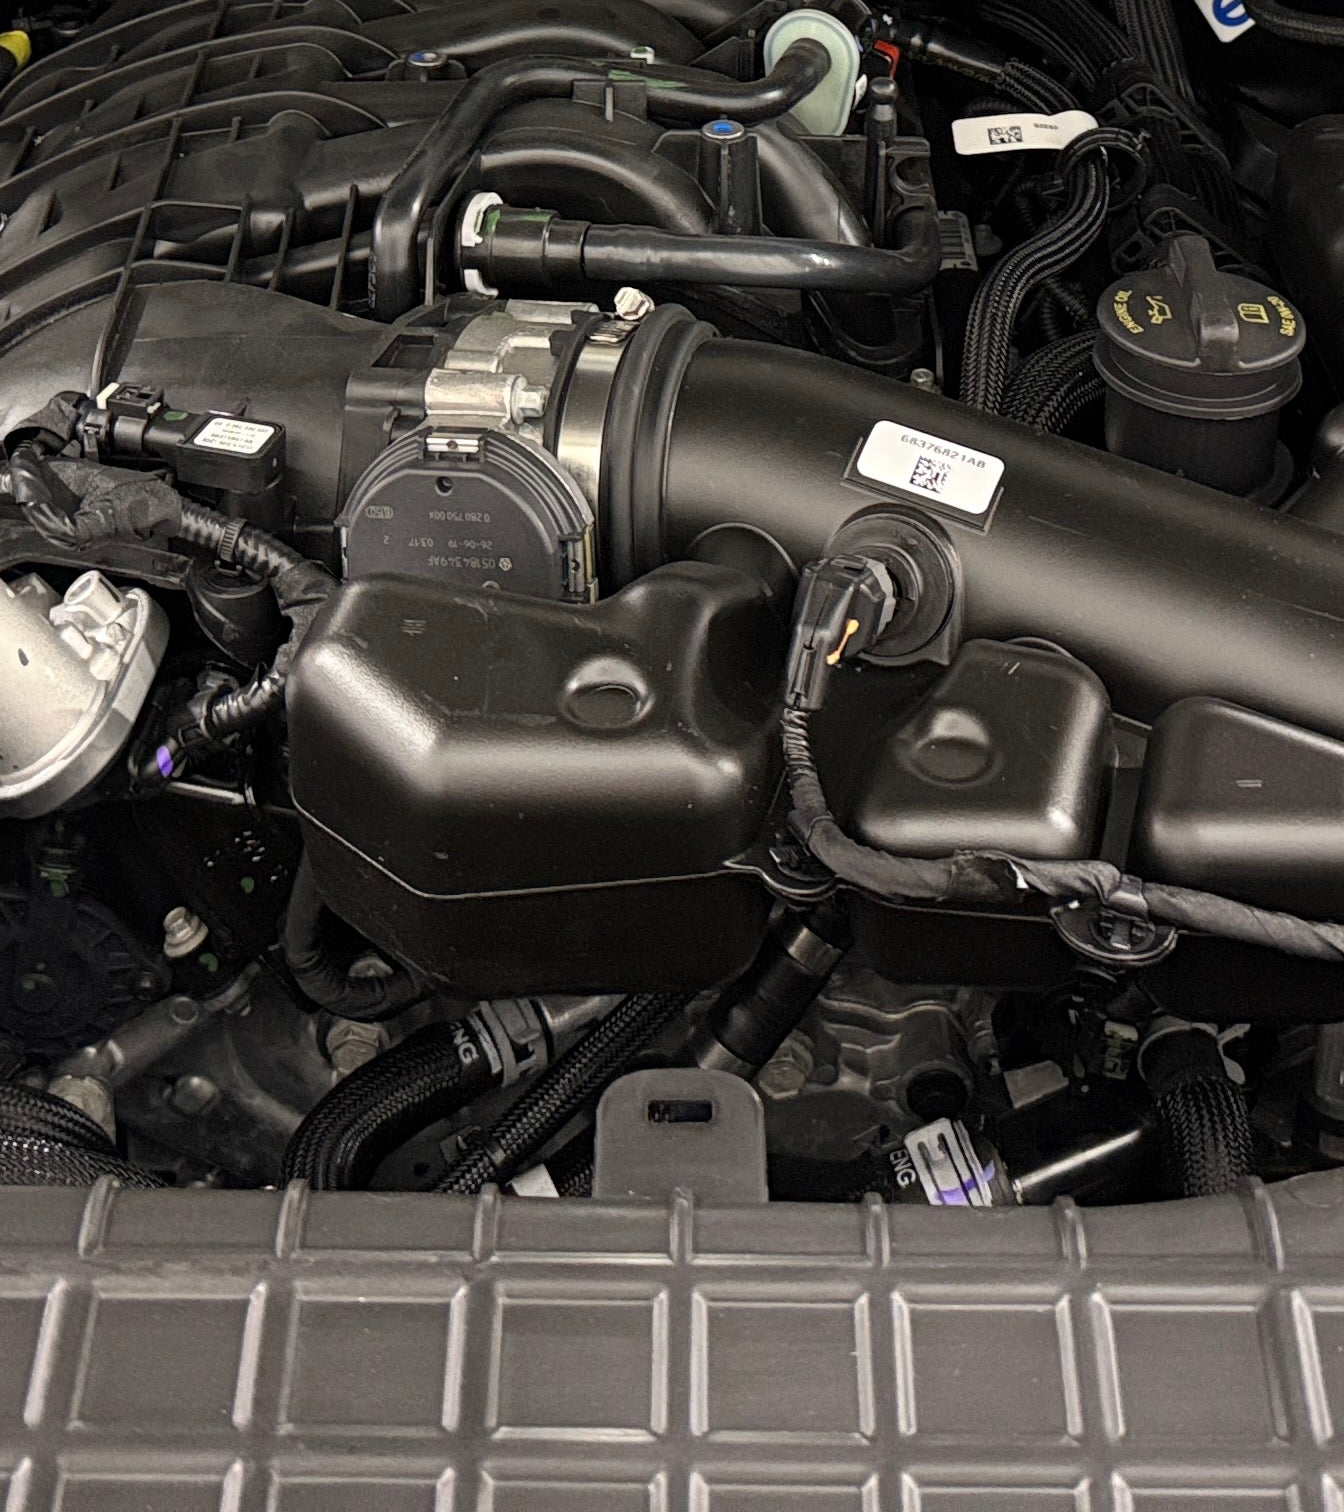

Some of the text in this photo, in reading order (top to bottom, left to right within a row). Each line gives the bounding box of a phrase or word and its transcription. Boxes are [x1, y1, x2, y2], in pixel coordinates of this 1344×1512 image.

[1114, 289, 1144, 334] ENGINE OIL
[1279, 319, 1296, 337] SAE
[900, 434, 987, 469] 68376821AB
[889, 1149, 917, 1189] ENG
